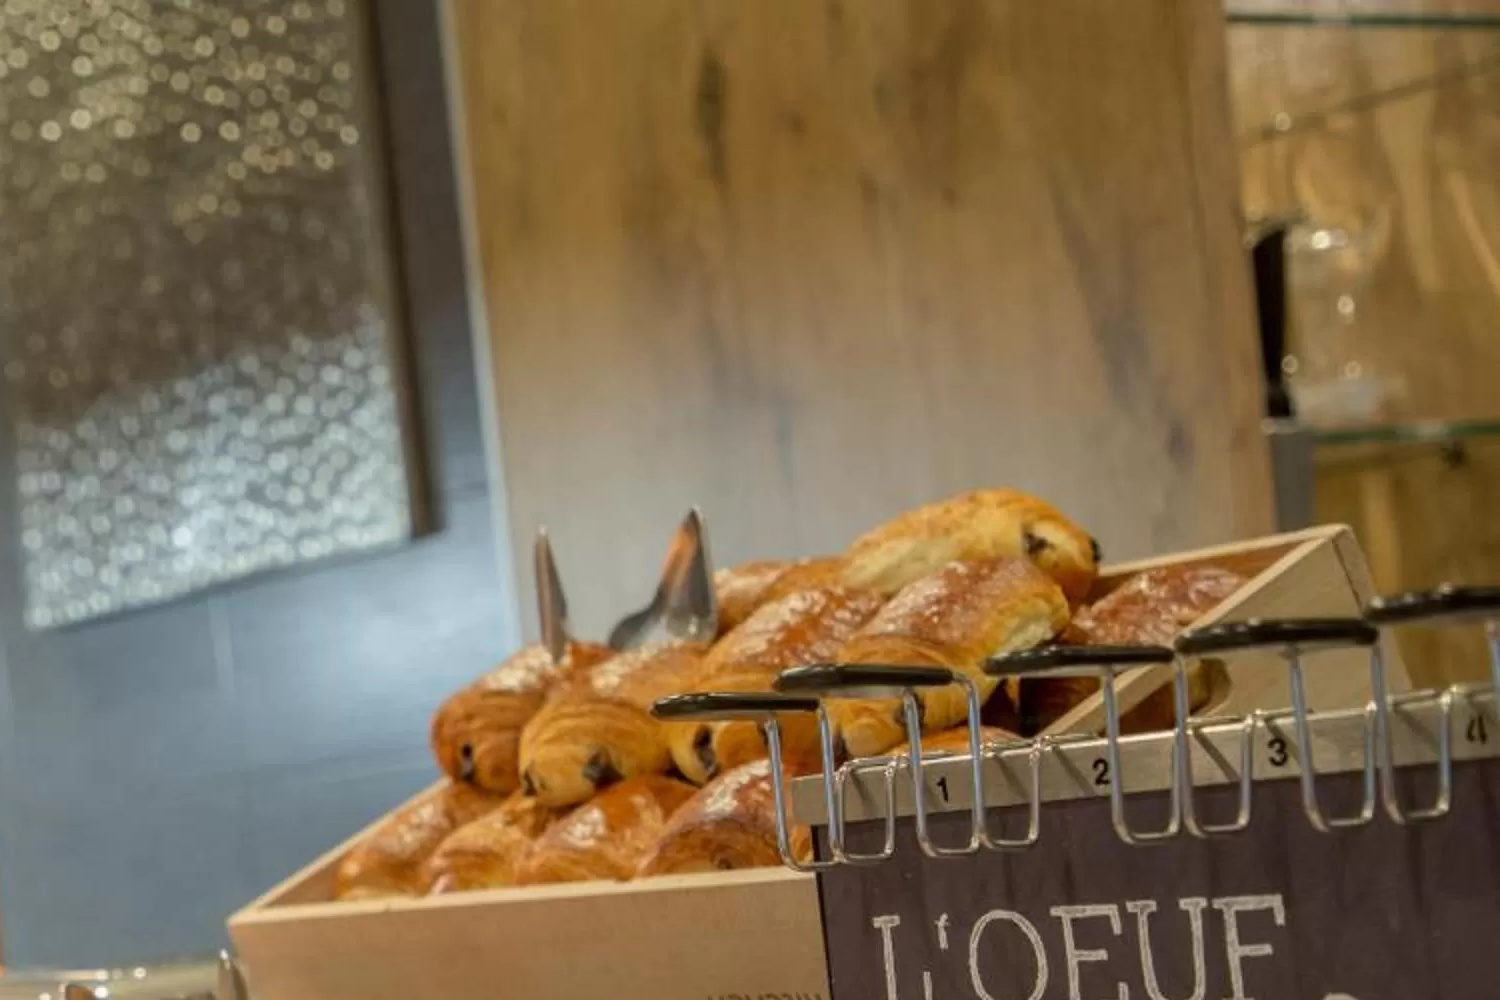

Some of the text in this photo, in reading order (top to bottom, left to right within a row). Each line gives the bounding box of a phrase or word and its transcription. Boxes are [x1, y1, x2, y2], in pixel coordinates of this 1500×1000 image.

[937, 776, 949, 802] 1
[1092, 758, 1110, 785] 2
[1267, 737, 1289, 766] 3
